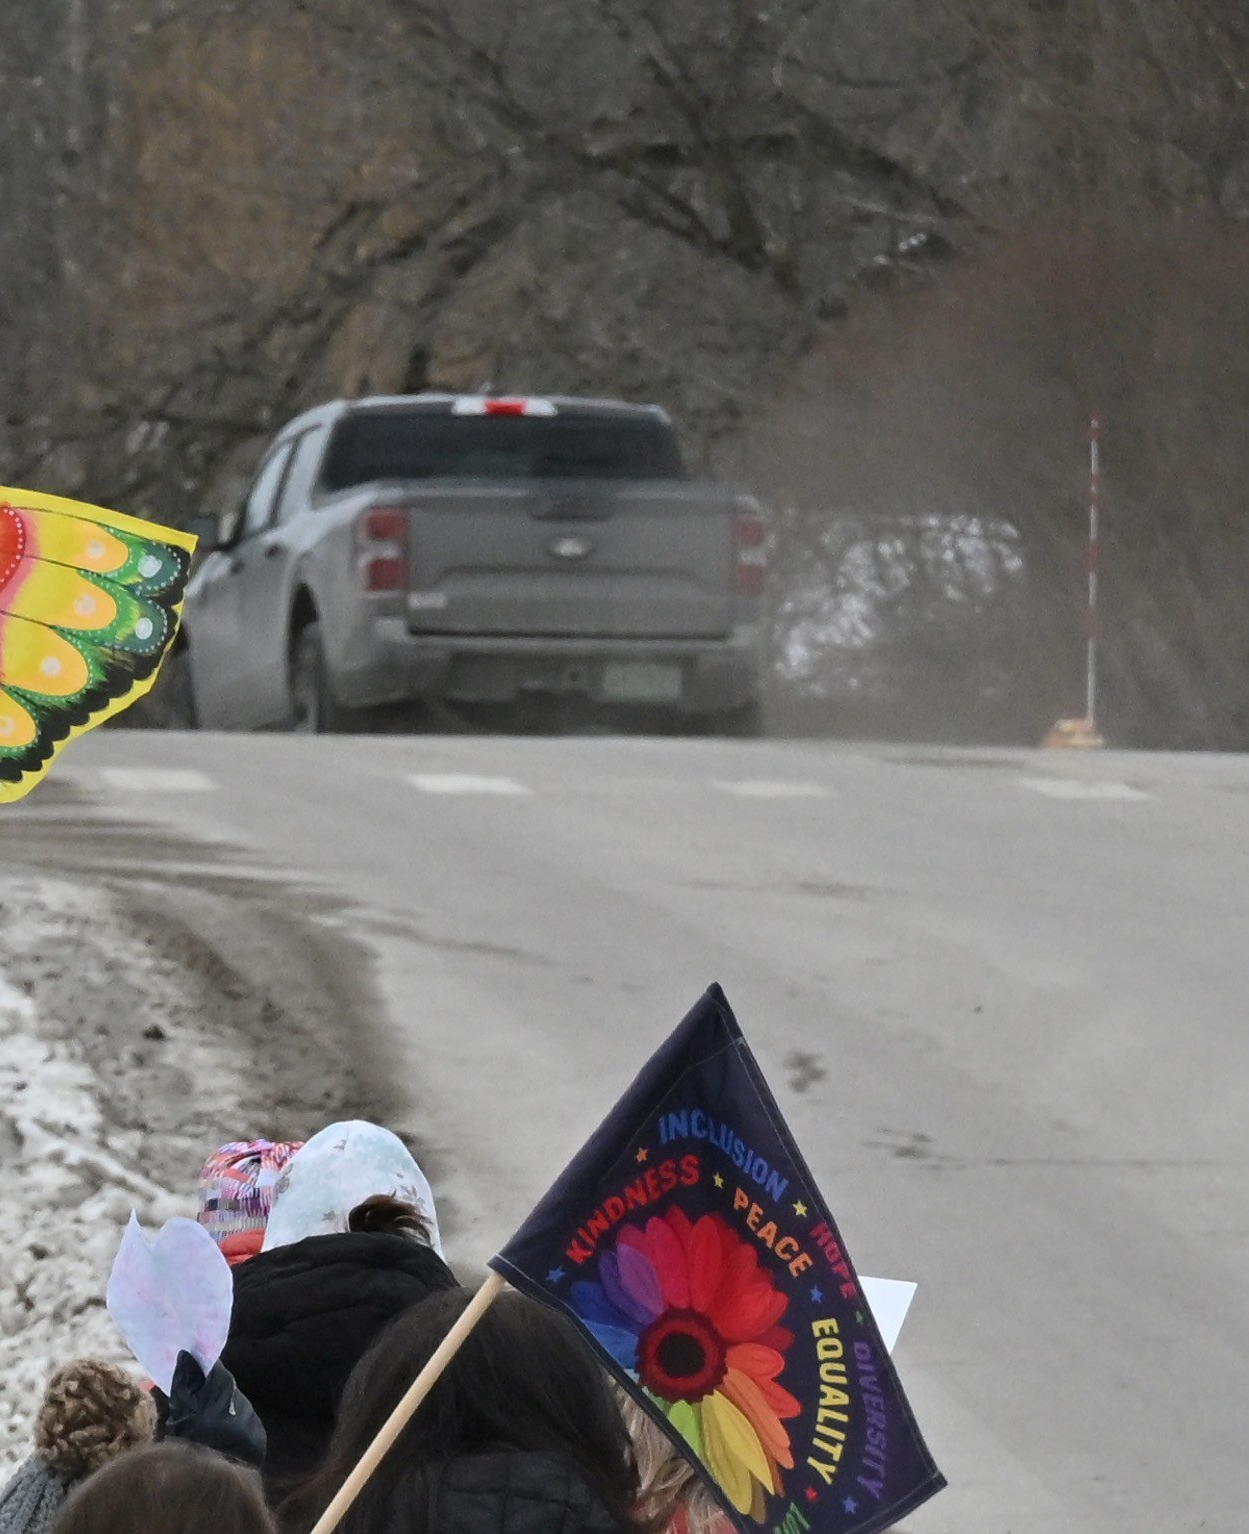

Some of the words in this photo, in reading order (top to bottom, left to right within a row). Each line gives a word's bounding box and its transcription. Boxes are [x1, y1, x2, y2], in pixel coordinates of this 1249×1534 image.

[658, 1108, 789, 1203] INCLUSION
[565, 1153, 700, 1265] KINDNESS
[733, 1187, 814, 1278] PEACE
[810, 1220, 857, 1300] HOPE
[806, 1317, 851, 1486] EQUALITY
[853, 1341, 887, 1499] DIVERSITY
